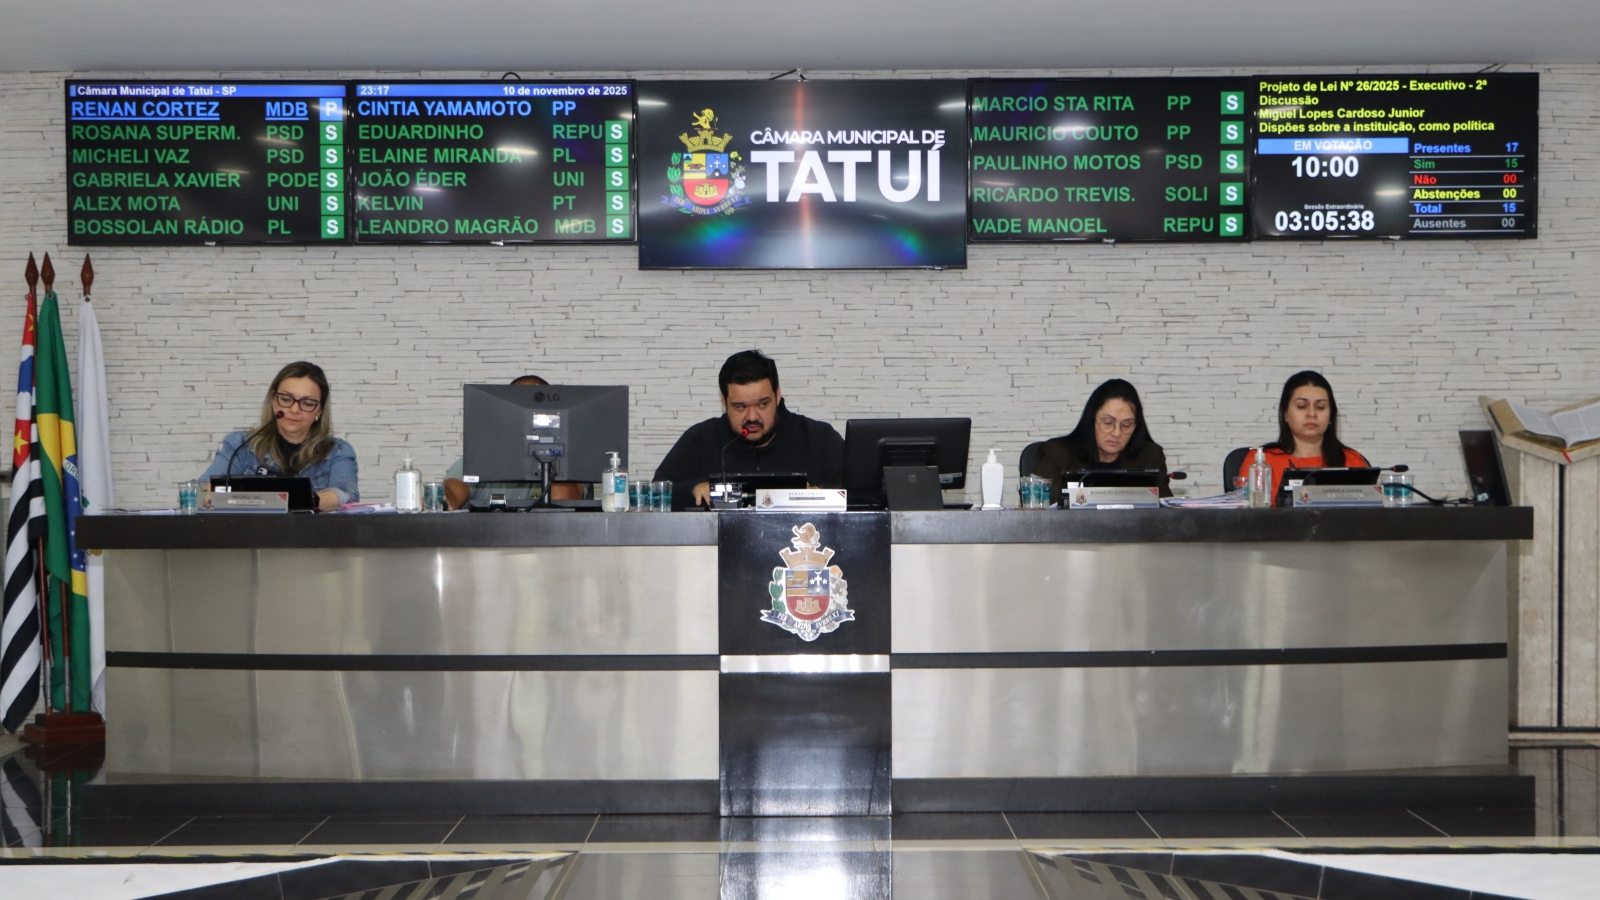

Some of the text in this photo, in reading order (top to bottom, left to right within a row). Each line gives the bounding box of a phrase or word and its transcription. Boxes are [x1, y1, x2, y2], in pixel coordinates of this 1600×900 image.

[78, 86, 117, 95] Câmara
[120, 86, 169, 97] Municipal
[172, 86, 185, 95] de
[188, 86, 212, 95] Tatuí
[222, 86, 236, 95] SP
[360, 86, 627, 95] 23:17 10 de novembro de 2025
[1260, 82, 1300, 93] Projeto
[1303, 82, 1317, 92] de
[1320, 82, 1337, 91] Lei
[1356, 81, 1399, 91] 26/2025
[1410, 81, 1465, 90] Executivo
[973, 95, 1238, 112] MARCIO STA RITA PP S
[1260, 96, 1319, 105] Discussão
[71, 102, 337, 116] RENAN CORTEZ MDB P
[358, 101, 576, 116] CINTIA YAMAMOTO PP
[1260, 108, 1424, 119] Miguel Lopes Cardoso Junior
[72, 125, 337, 140] ROSANA SUPERM. PSD S
[359, 124, 622, 139] EDUARDINHO REPU S
[974, 125, 1238, 141] MAURICIO COUTO PP S
[1260, 123, 1306, 134] Dispões
[1308, 122, 1341, 132] sobre
[1353, 122, 1415, 133] instituição,
[1453, 121, 1494, 133] política
[750, 128, 945, 145] CÂMARA MUNICIPAL DE
[1294, 139, 1372, 152] EM VOTAÇÃO
[1414, 143, 1518, 153] Presentes 17
[72, 149, 338, 164] MICHELI VAZ PSD S
[359, 148, 623, 163] ELAINE MIRANDA PL S
[974, 154, 1238, 170] PAULINHO MOTOS PSD S
[1292, 156, 1359, 177] 10:00
[1414, 159, 1518, 169] Sim 15
[73, 172, 338, 188] GABRIELA XAVIER PODE S
[358, 168, 623, 187] JOÃO ÉDER UNI S
[751, 145, 943, 202] TATUÍ
[1414, 174, 1517, 185] Não 00
[974, 186, 1238, 202] RICARDO TREVIS. SOLI S
[1414, 189, 1516, 200] Abstenções 00
[73, 196, 338, 211] ALEX MOTA UNI S
[358, 196, 623, 210] KELVIN PT S
[1414, 203, 1516, 213] Total 15
[74, 216, 338, 235] BOSSOLAN RÁDIO PL S
[358, 216, 624, 234] LEANDRO MAGRÃO MDB S
[973, 217, 1237, 233] VADE MANOEL REPU S
[1275, 211, 1374, 231] 03:05:38
[1414, 218, 1515, 228] Ausentes 00
[777, 613, 787, 622] PER
